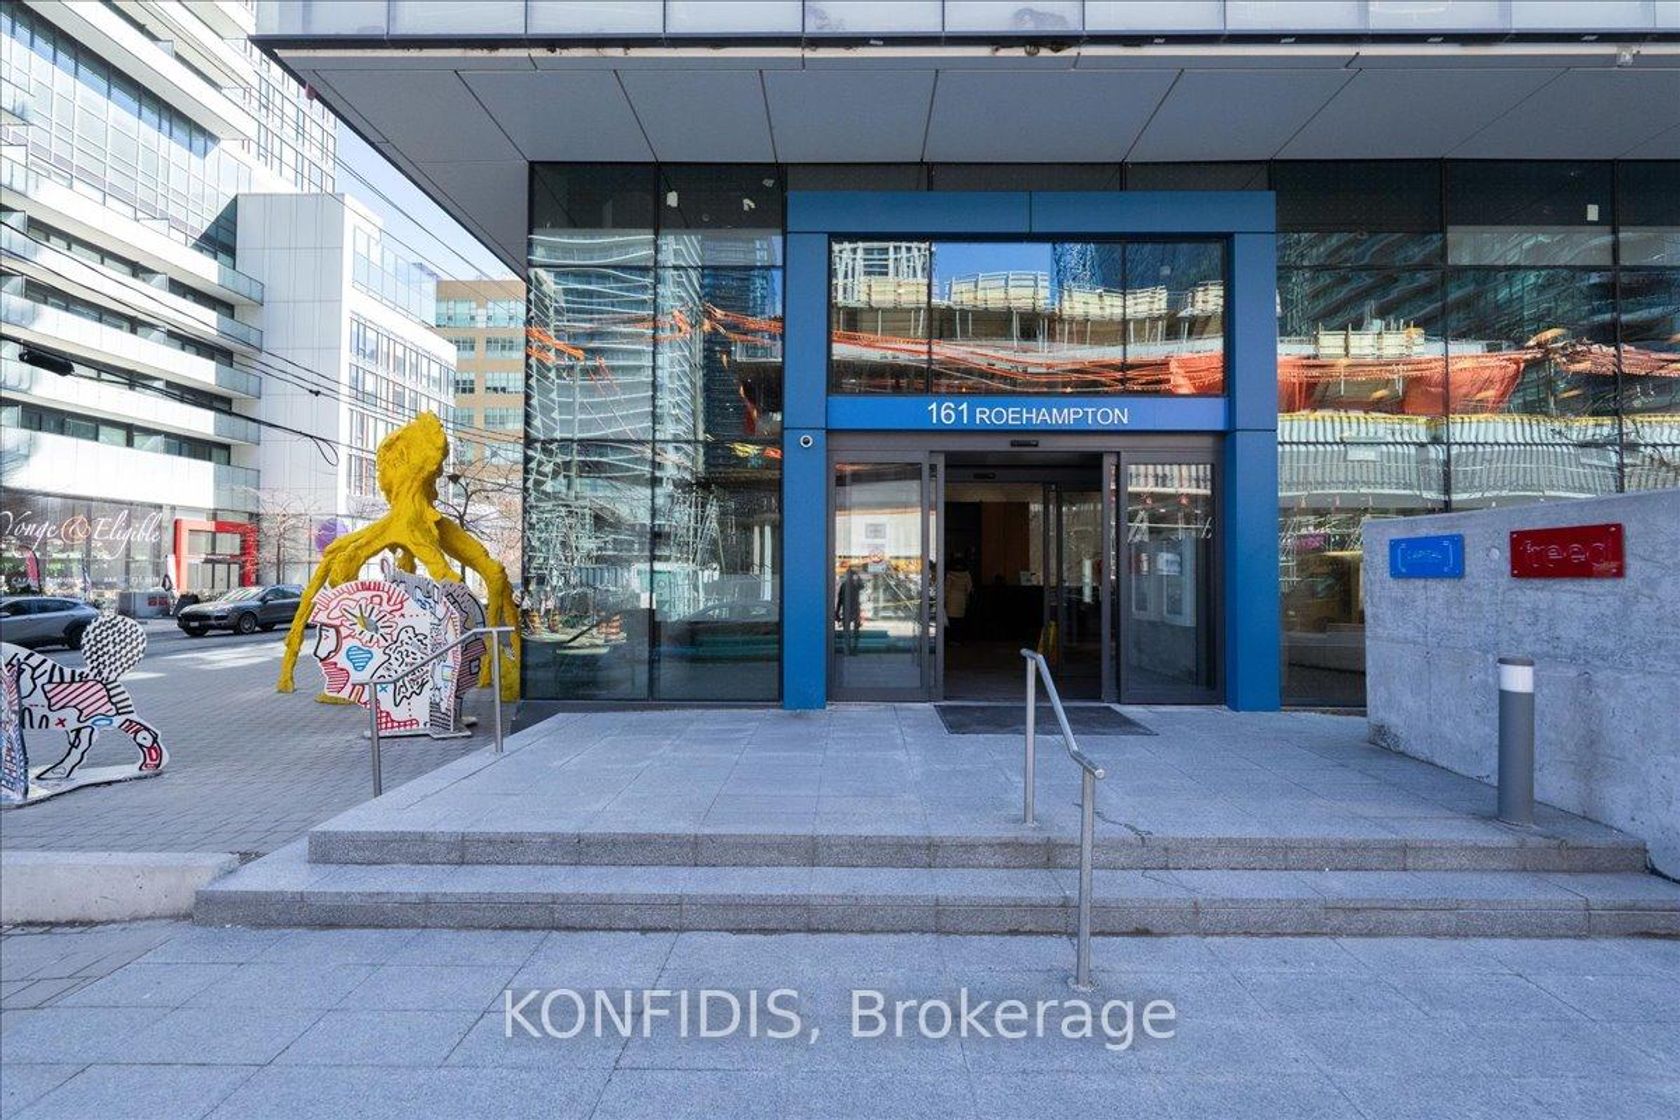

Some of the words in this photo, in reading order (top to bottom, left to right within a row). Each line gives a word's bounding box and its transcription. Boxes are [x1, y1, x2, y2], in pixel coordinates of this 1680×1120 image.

[927, 402, 968, 425] 161
[975, 407, 1129, 425] ROEHAMPTON
[61, 514, 92, 545] &
[92, 509, 163, 560] Eligible
